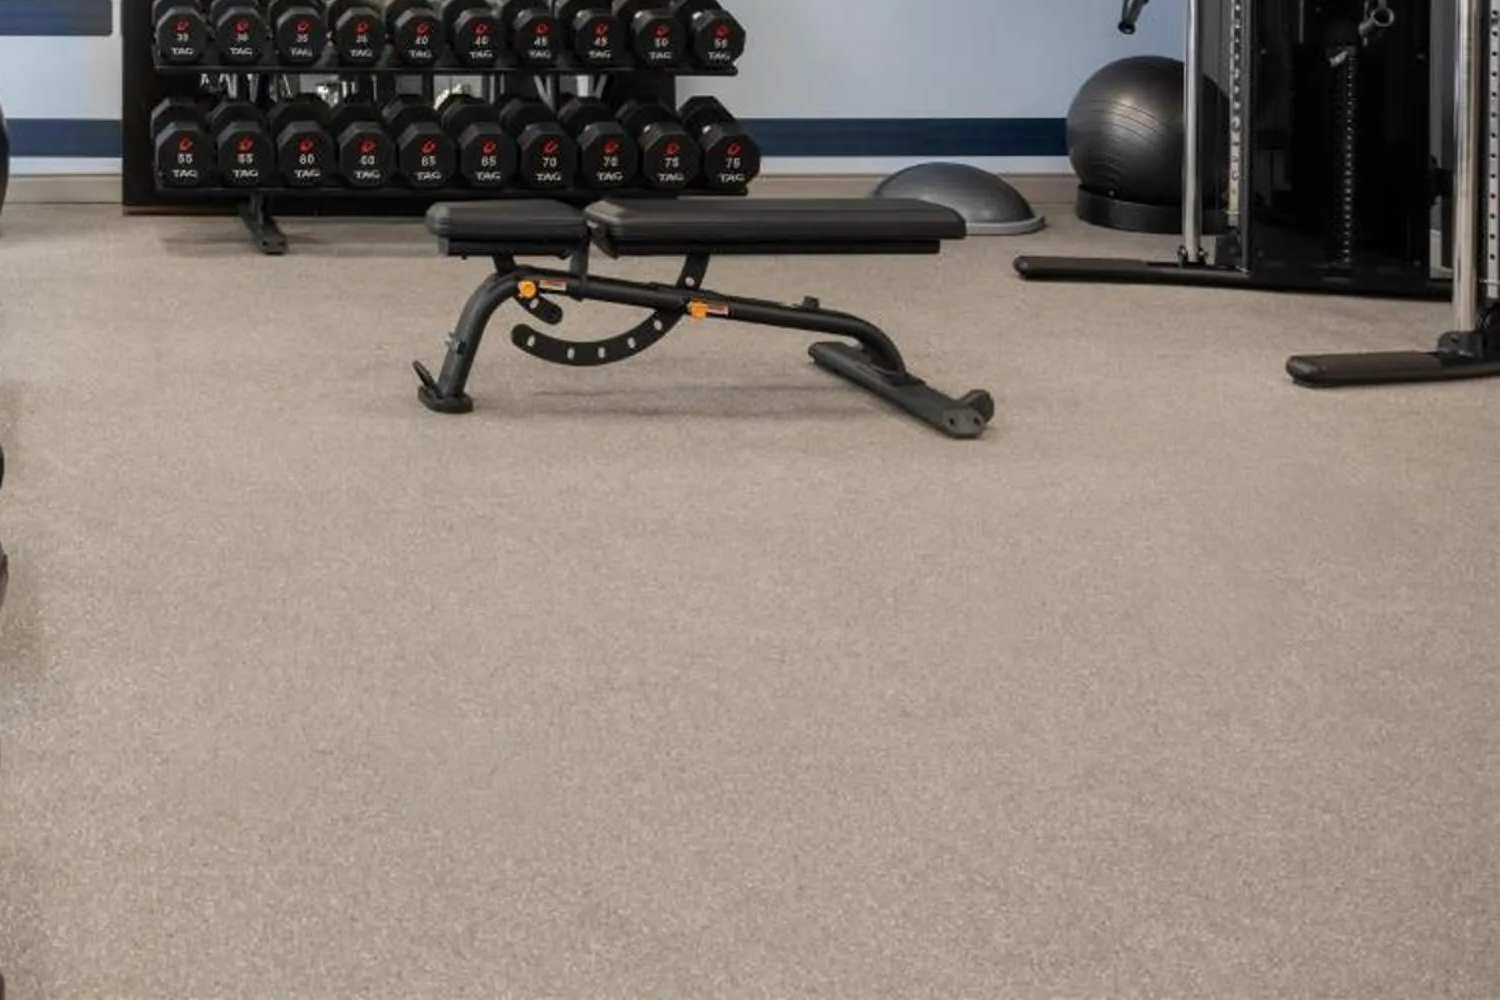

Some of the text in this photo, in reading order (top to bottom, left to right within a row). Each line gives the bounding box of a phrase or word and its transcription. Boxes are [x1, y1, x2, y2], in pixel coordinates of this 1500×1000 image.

[408, 49, 432, 59] TAG
[469, 50, 493, 59] TAG
[588, 50, 611, 59] TAG
[649, 51, 672, 60] TAG
[421, 155, 437, 167] 65
[481, 155, 497, 167] 65
[542, 156, 557, 168] 70
[664, 157, 679, 168] 75
[172, 169, 198, 178] TAG
[232, 169, 259, 178] TAG
[294, 169, 321, 178] TAG
[354, 170, 381, 179] TAG
[416, 171, 442, 181] TAG
[476, 171, 501, 181] TAG
[536, 172, 562, 182] TAG
[596, 171, 624, 181] TAG
[658, 172, 684, 182] TAG
[718, 173, 745, 183] TAG
